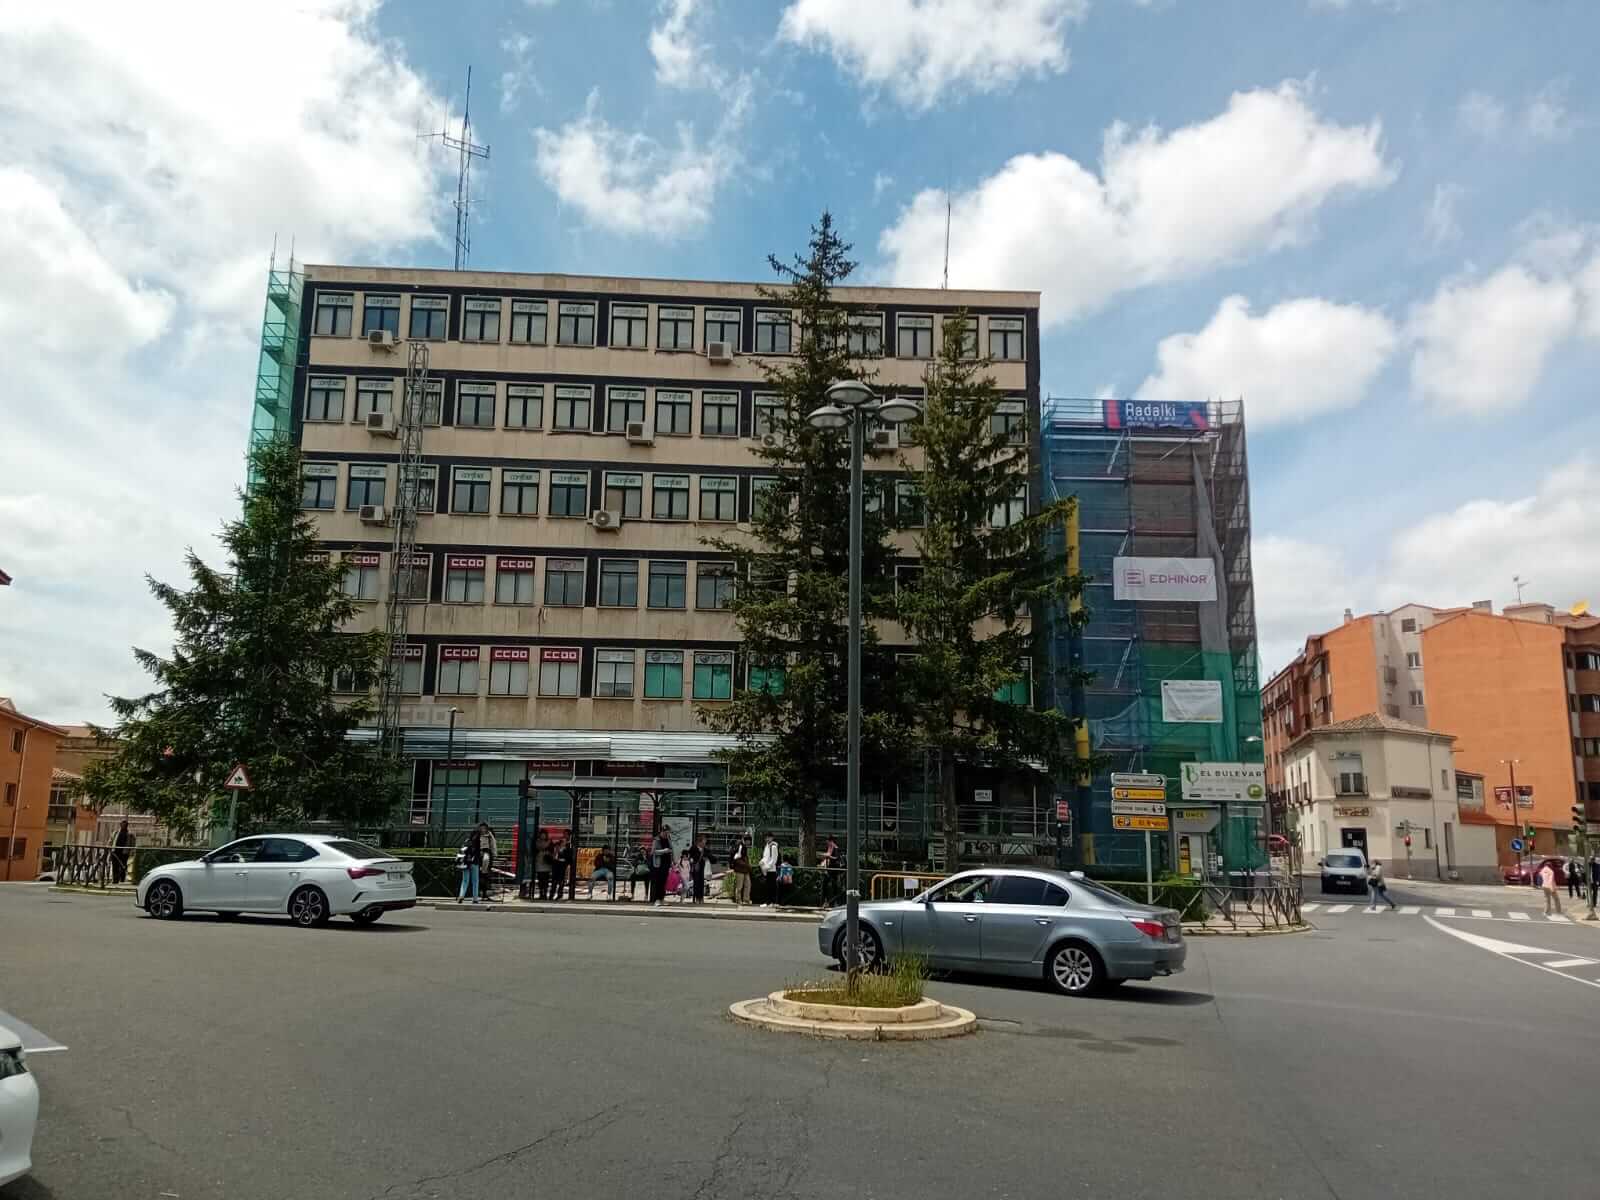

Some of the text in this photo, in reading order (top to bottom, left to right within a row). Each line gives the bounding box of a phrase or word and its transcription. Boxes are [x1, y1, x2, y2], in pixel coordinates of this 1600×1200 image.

[1125, 403, 1176, 417] Radalki
[451, 558, 485, 567] CCOO
[500, 560, 533, 569] CCOO
[1150, 574, 1208, 584] EDHINOR
[445, 649, 478, 657] CCOO
[494, 650, 527, 658] CCOO
[543, 651, 577, 659] CCOO
